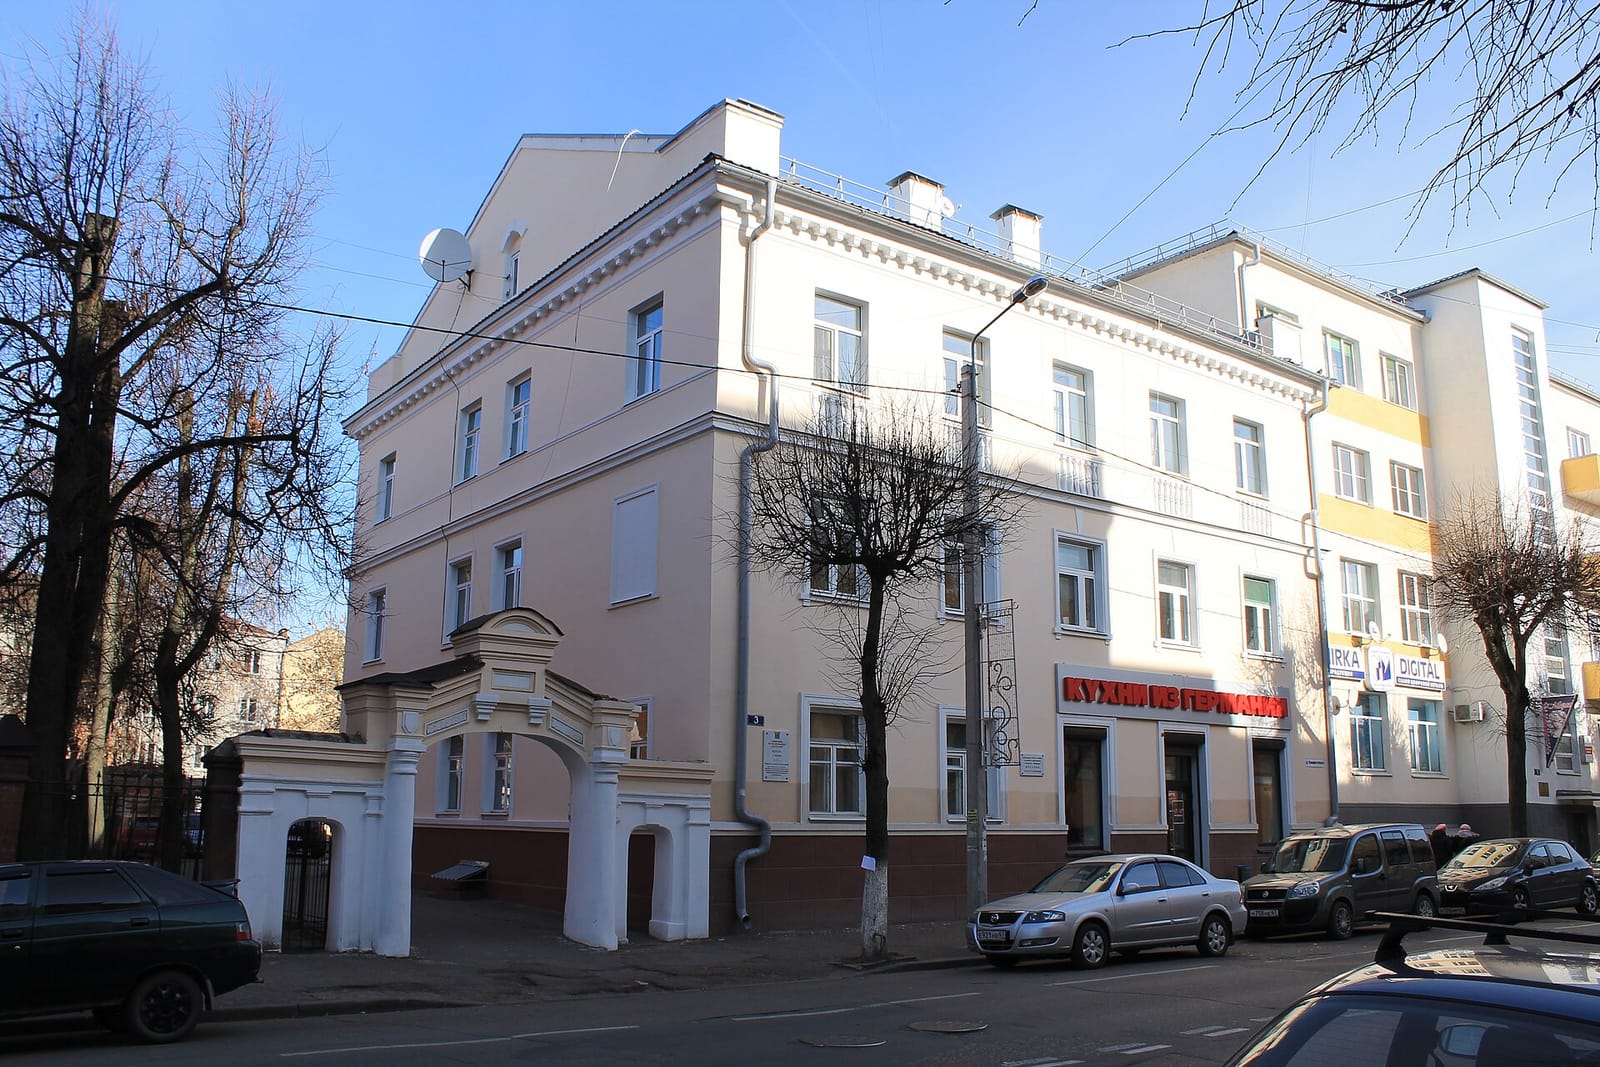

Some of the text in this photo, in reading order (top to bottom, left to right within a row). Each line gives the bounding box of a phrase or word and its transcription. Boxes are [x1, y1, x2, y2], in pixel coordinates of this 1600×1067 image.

[1399, 658, 1441, 680] DIGITAL
[1063, 677, 1289, 718] КУХНИ ИЗ ГЕРМАНИИ
[753, 715, 759, 724] 3
